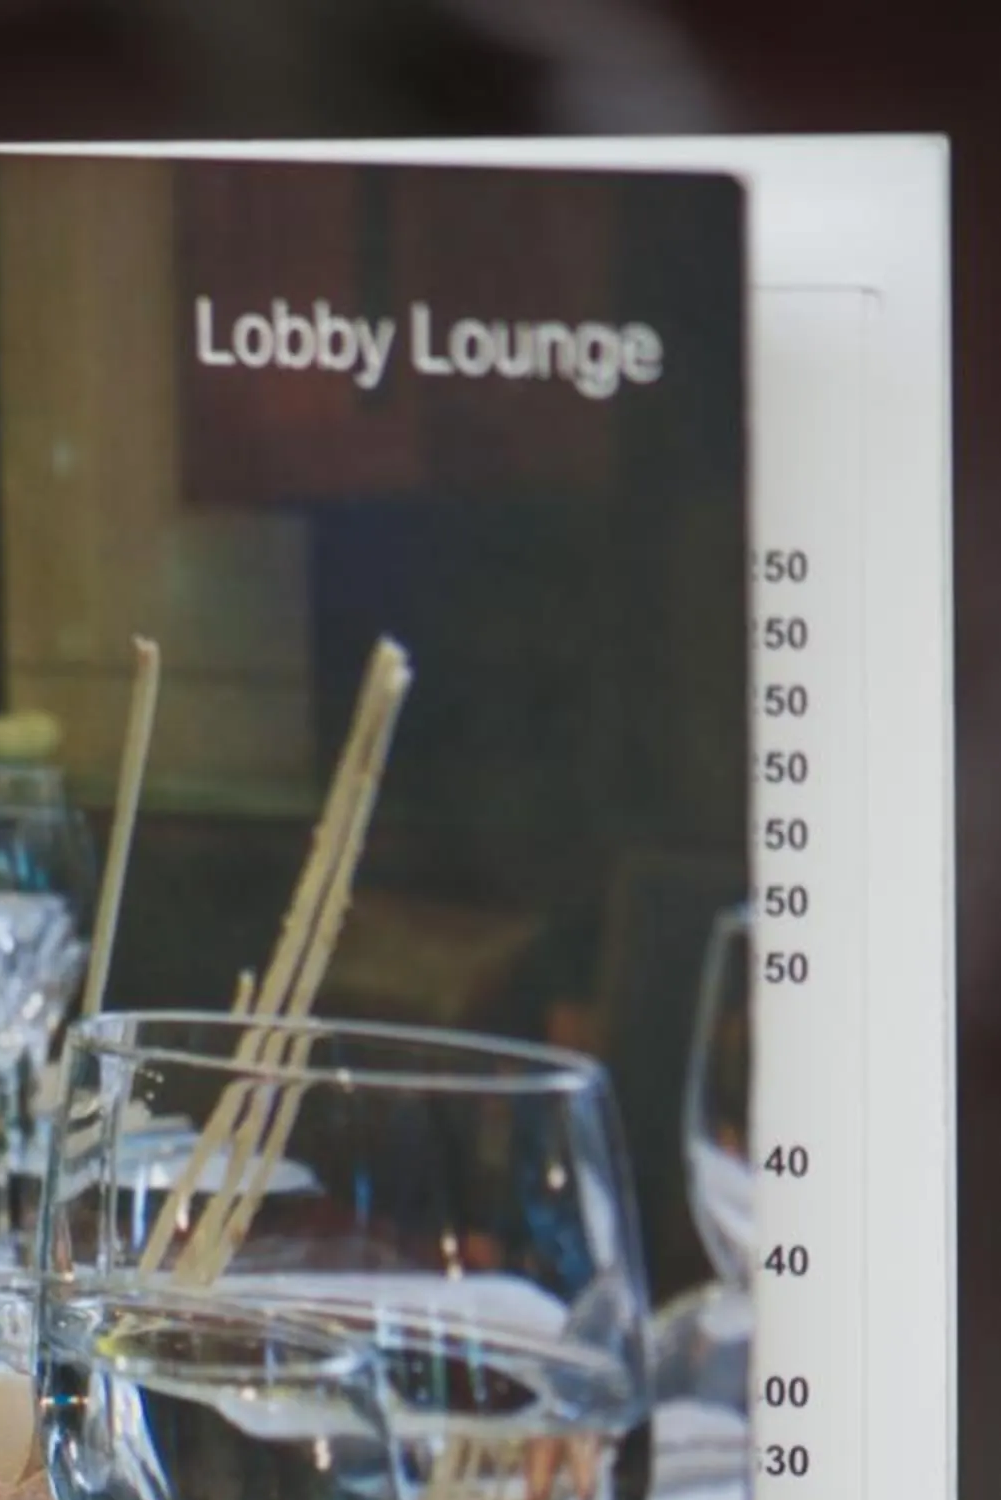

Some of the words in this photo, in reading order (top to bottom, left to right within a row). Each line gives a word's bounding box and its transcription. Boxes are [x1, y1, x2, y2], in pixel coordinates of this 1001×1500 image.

[195, 295, 395, 390] Lobby
[410, 302, 663, 399] Lounge
[753, 549, 809, 583] 50
[753, 616, 809, 650] 50
[753, 684, 809, 717] 50
[753, 750, 809, 784] 50
[754, 818, 809, 851] 50
[755, 885, 809, 918] 50
[756, 951, 809, 984] 50
[758, 1145, 810, 1178] 40
[758, 1244, 810, 1277] 40
[757, 1375, 810, 1408] 00
[756, 1444, 810, 1477] 30
